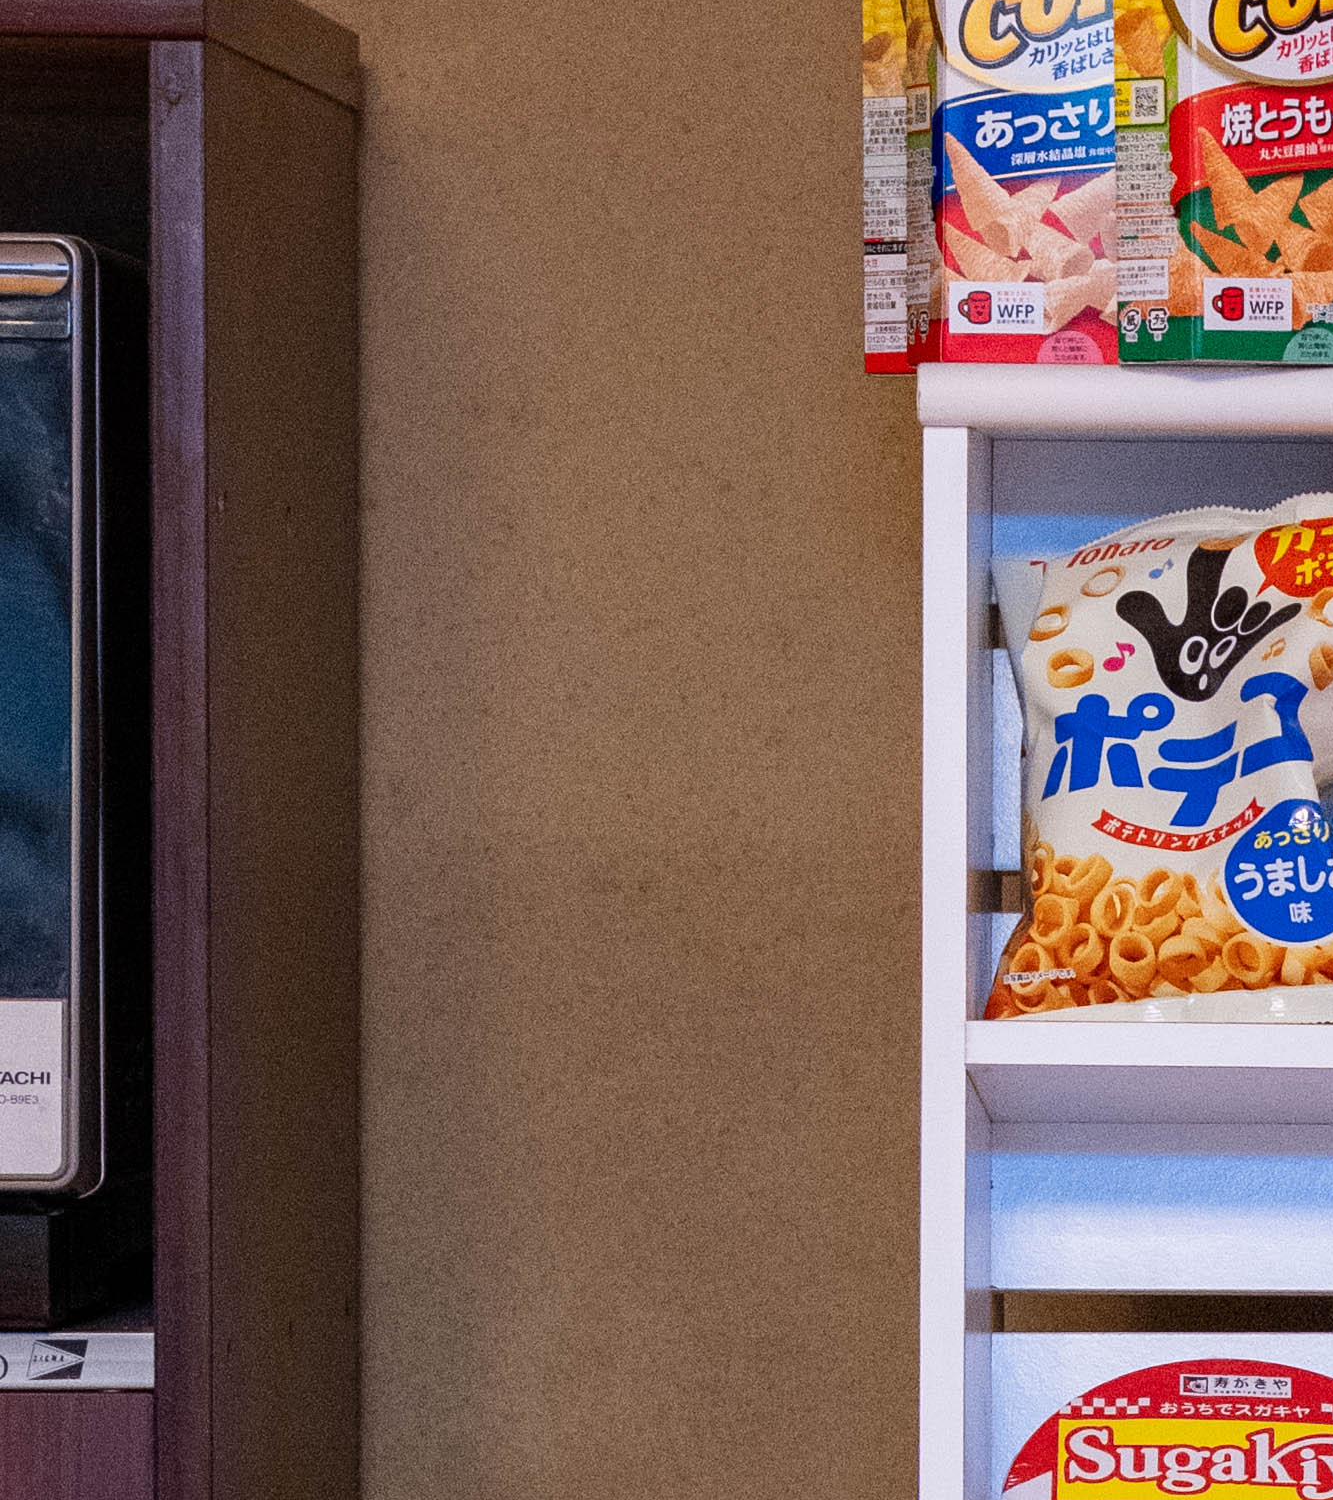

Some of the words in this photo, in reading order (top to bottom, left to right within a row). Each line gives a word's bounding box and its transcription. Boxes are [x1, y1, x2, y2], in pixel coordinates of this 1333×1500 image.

[975, 99, 1116, 148] あっさり
[1011, 146, 1086, 165] 深層水結晶塩
[998, 306, 1034, 318] WFP
[1249, 301, 1284, 315] WFP
[1042, 672, 1313, 826] ポテコ
[1103, 807, 1255, 847] ポテトリングスナック
[1254, 823, 1331, 848] あっさり
[1290, 900, 1313, 923] 味
[1214, 1376, 1288, 1389] 寿がきや
[1160, 1402, 1311, 1418] おうちでスガキヤ
